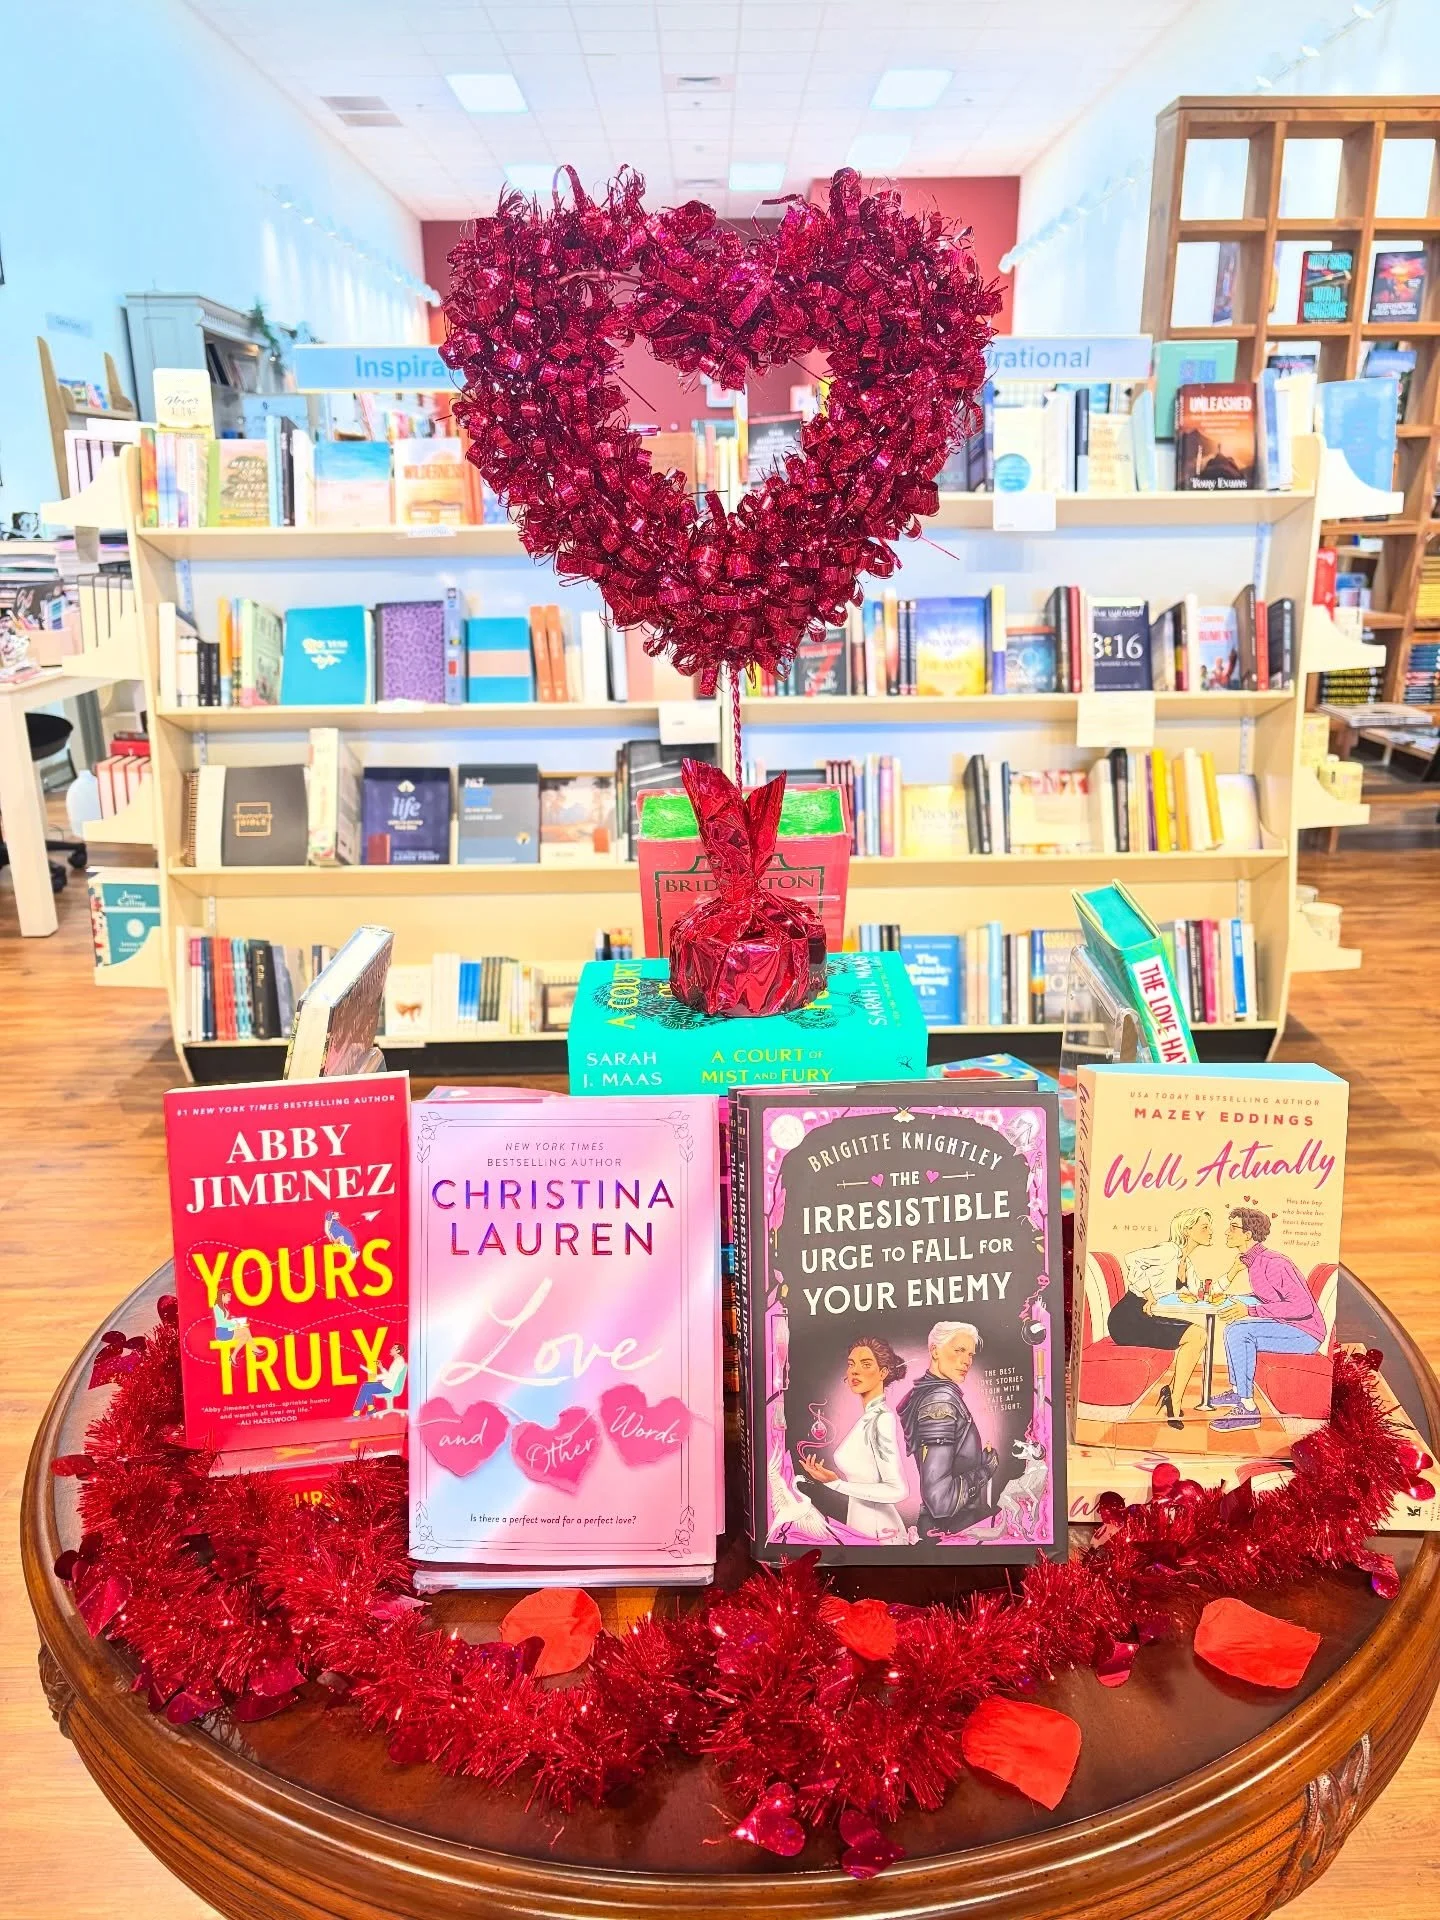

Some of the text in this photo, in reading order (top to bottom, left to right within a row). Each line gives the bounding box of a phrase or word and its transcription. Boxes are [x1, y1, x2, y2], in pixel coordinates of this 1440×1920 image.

[1189, 395, 1252, 413] UNLEASHED
[1190, 477, 1248, 491] Tony Evans
[392, 796, 421, 820] life
[665, 875, 815, 893] BRIDTON
[607, 963, 642, 1009] COURT
[1140, 964, 1165, 994] THE
[1149, 996, 1177, 1035] LOVE
[586, 1052, 657, 1067] SARAH
[711, 1048, 823, 1063] A COURT OF
[602, 1071, 663, 1087] MAAS
[701, 1068, 833, 1084] MIST AND FURY
[177, 1094, 396, 1117] #1 NEW YORK TIMES BESTSELLING AUTHOR
[1130, 1091, 1320, 1106] USA TODAY BESTSELLING AUTHOR
[1134, 1107, 1314, 1127] MAZEY EDDINGS
[226, 1123, 352, 1164] ABBY
[505, 1142, 605, 1151] NEW YORK TIMES
[807, 1131, 1003, 1173] BRIGITTE KNIGHTLEY
[487, 1158, 622, 1167] BESTSELLING AUTHOR
[1103, 1138, 1336, 1199] Well, Actually
[186, 1163, 396, 1215] JIMENEZ
[889, 1171, 920, 1187] THE
[431, 1179, 675, 1210] CHRISTINA
[802, 1190, 1010, 1235] IRRESISTIBLE
[1124, 1224, 1159, 1232] NOVEL
[450, 1222, 653, 1256] LAUREN
[801, 1236, 1013, 1274] URGE TO FALL FOR
[192, 1238, 393, 1308] YOURS
[802, 1271, 1013, 1316] YOUR ENEMY
[440, 1276, 663, 1387] Love
[209, 1326, 388, 1395] TRULY
[985, 1367, 1016, 1377] THE BEST
[996, 1375, 1024, 1385] STORIES
[986, 1396, 1003, 1404] ATE
[1000, 1403, 1022, 1411] SIGHT.
[220, 1412, 233, 1420] and
[233, 1411, 259, 1419] warmth
[285, 1408, 296, 1416] my
[253, 1415, 298, 1425] HAZELWOOD
[610, 1405, 682, 1444] Words
[439, 1417, 488, 1447] and
[526, 1433, 596, 1476] Other
[470, 1514, 477, 1522] Is
[479, 1514, 500, 1523] there
[509, 1514, 538, 1526] perfect
[540, 1515, 560, 1524] word
[562, 1515, 575, 1527] for
[584, 1515, 613, 1527] perfect
[615, 1515, 637, 1525] love?
